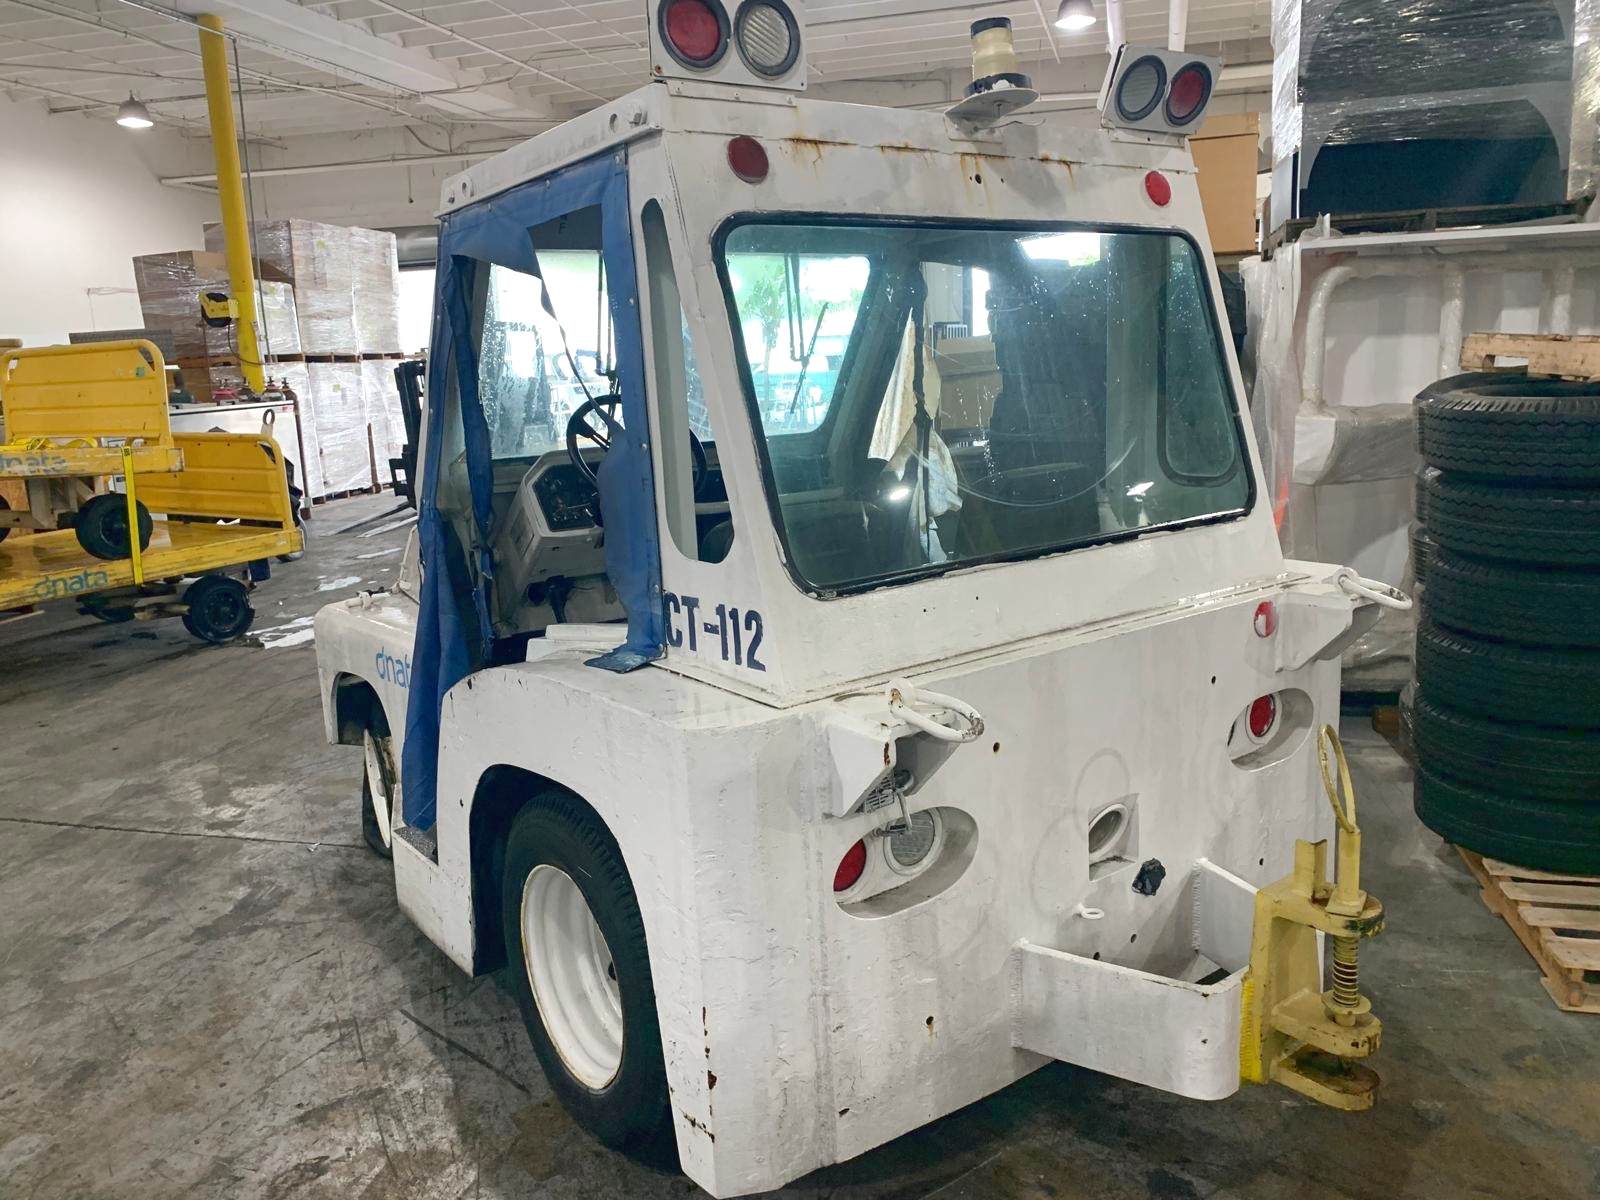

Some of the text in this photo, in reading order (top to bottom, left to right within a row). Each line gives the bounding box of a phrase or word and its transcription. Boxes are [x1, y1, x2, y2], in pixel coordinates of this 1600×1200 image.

[0, 453, 67, 474] nata
[34, 568, 109, 600] dnata
[663, 592, 767, 672] CT-112
[375, 645, 411, 689] dnat
